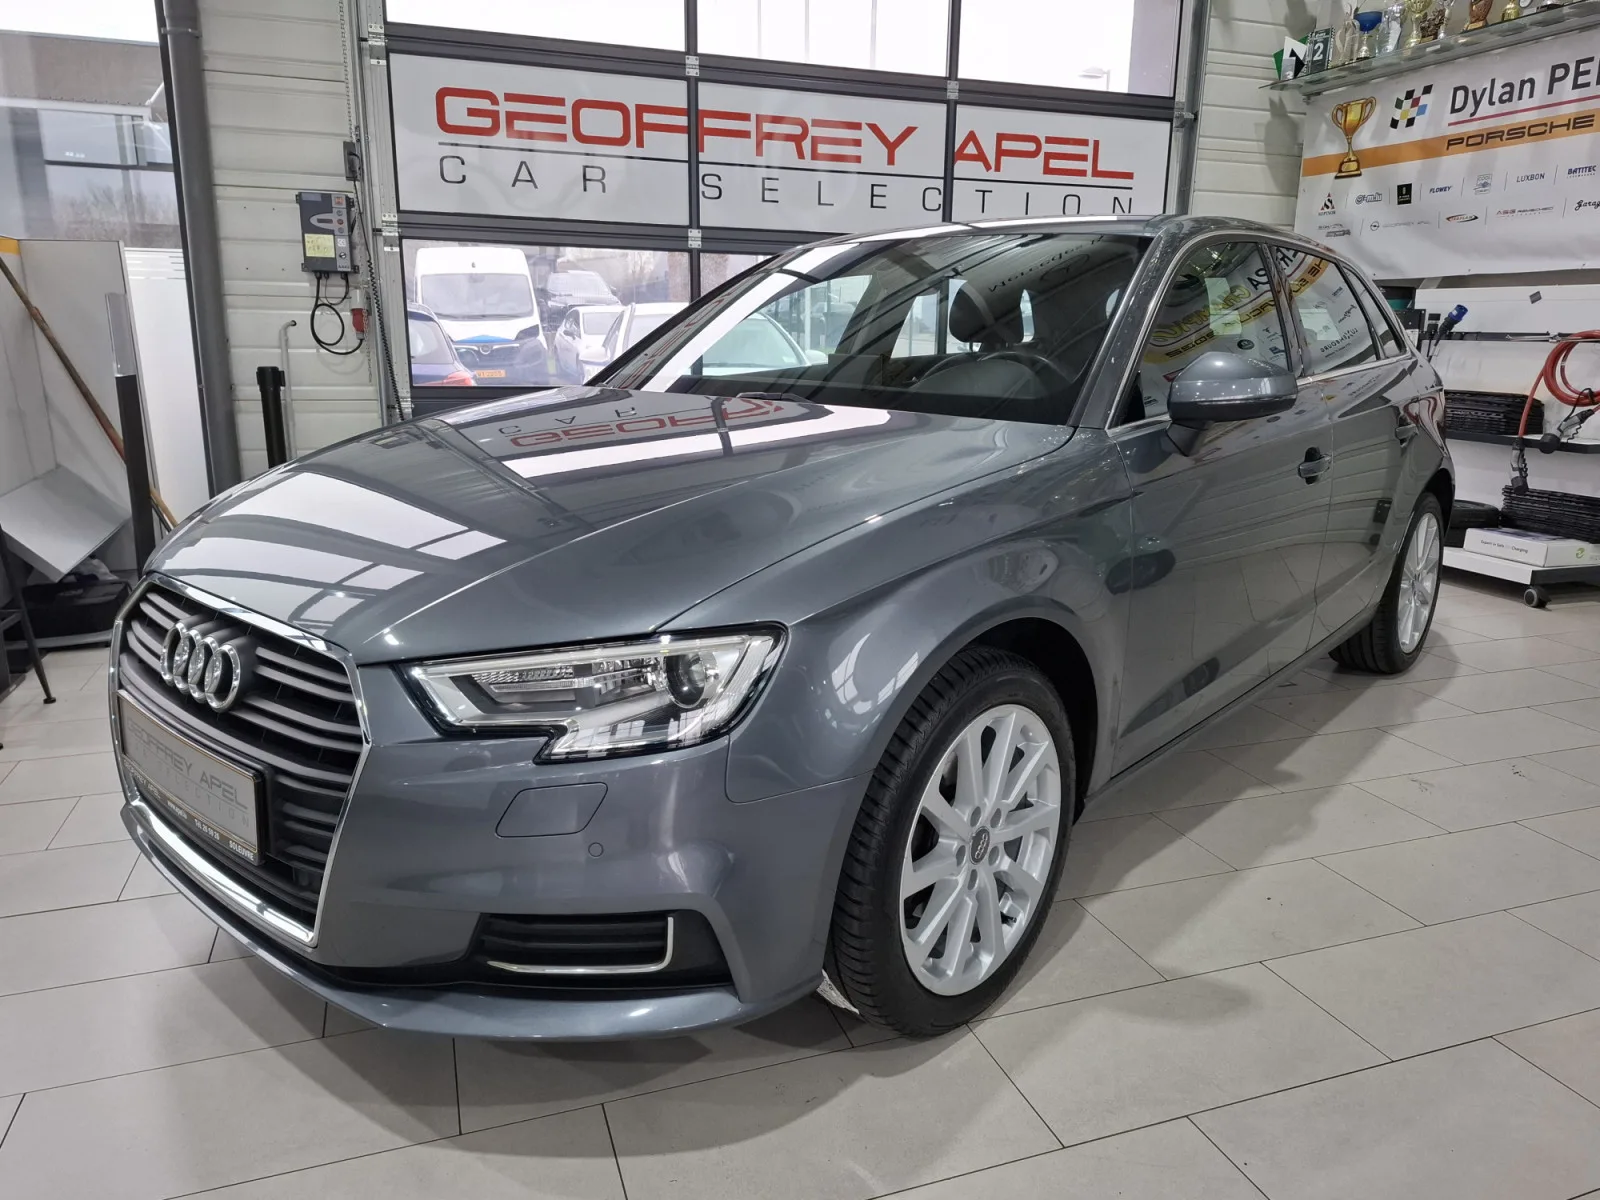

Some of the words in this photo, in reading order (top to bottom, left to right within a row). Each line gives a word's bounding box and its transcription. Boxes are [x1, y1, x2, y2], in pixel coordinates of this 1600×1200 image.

[1313, 43, 1324, 61] 2
[1449, 73, 1536, 117] Dylan
[435, 86, 918, 166] GEOFFREY
[954, 129, 1134, 181] APEL
[1446, 113, 1595, 151] PORSCHE
[438, 155, 607, 193] CAR
[701, 172, 1133, 215] SELECTION
[1516, 172, 1545, 183] LUXBON
[1567, 165, 1597, 176] BATITEC
[1429, 185, 1452, 194] FLOWEY
[200, 771, 248, 810] APEL
[229, 841, 254, 861] SOLEUVRE
